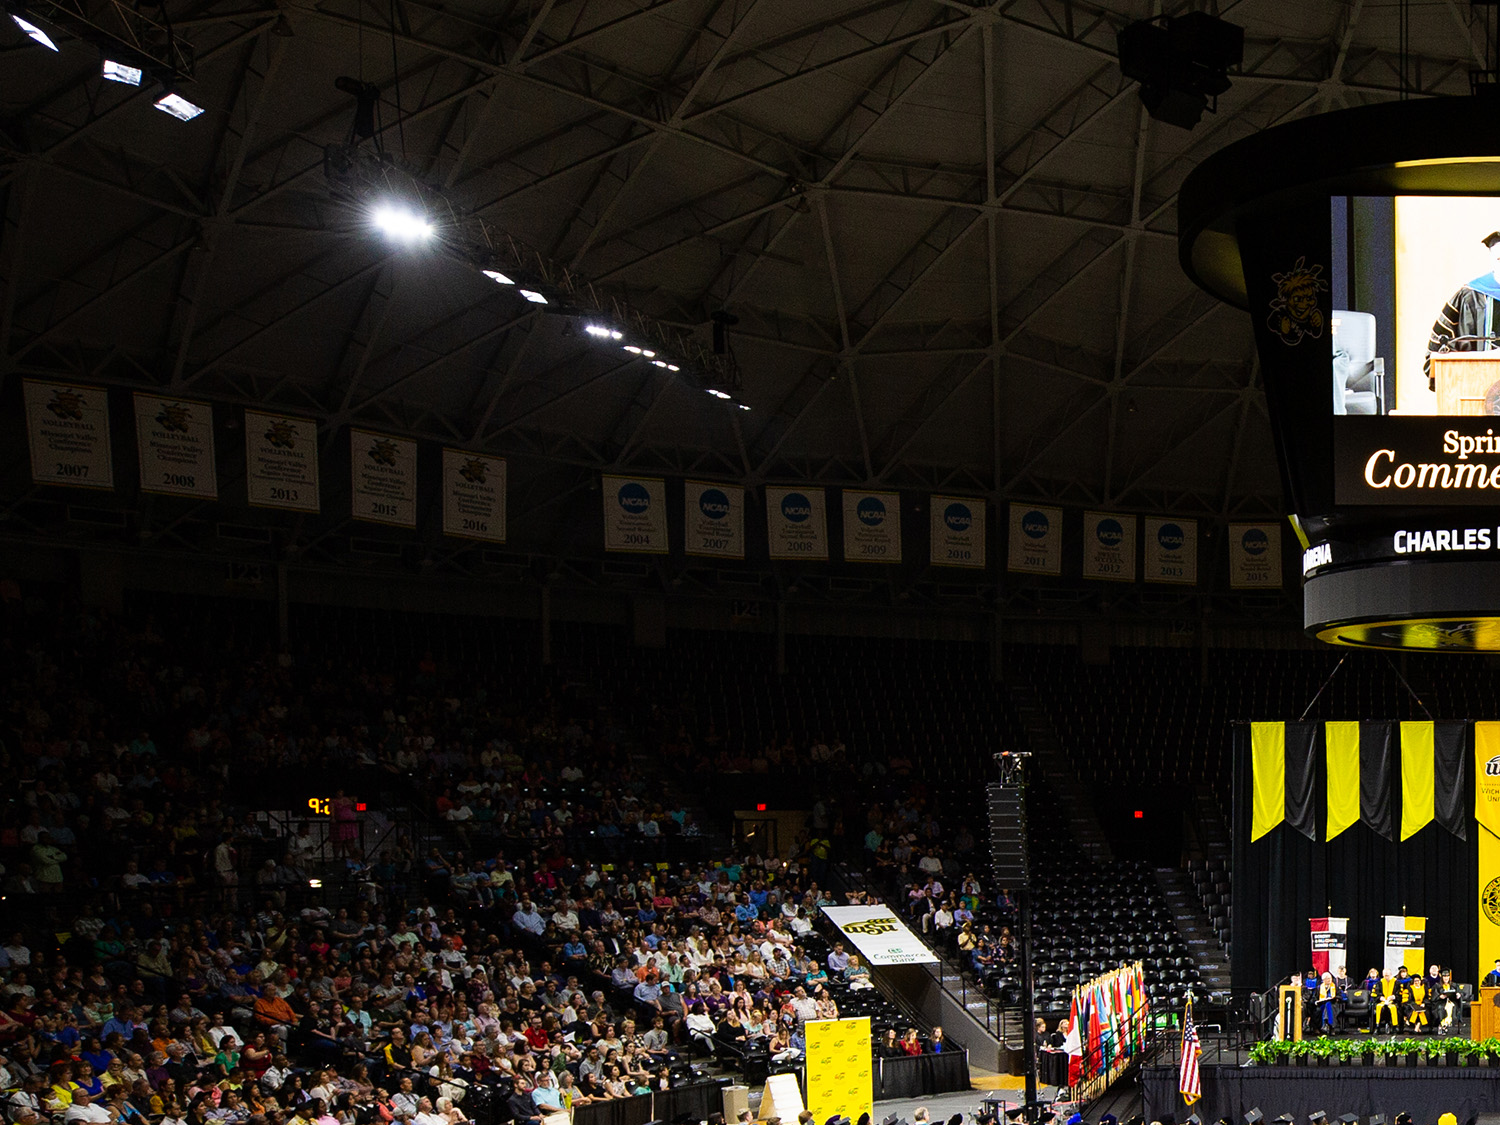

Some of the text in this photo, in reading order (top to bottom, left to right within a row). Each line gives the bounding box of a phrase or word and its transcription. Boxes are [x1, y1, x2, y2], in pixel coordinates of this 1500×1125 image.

[42, 419, 96, 431] VOLLEYBALL
[74, 432, 98, 443] Valley
[151, 430, 200, 443] VOLLEYBALL
[259, 447, 305, 459] VOLLEYBALL
[56, 462, 89, 477] 2007
[364, 464, 405, 476] VOLLEYBALL
[163, 472, 196, 488] 2008
[454, 481, 495, 493] VOLLEYBALL
[269, 487, 299, 501] 2013
[621, 497, 650, 507] NCAA
[702, 502, 730, 513] NCAA
[371, 502, 398, 517] 2015
[784, 506, 811, 516] NCAA
[860, 510, 887, 519] NCAA
[462, 518, 488, 533] 2016
[947, 516, 972, 525] NCAA
[1025, 522, 1048, 532] NCAA
[623, 533, 650, 545] 2004
[1099, 530, 1122, 540] NCAA
[1160, 535, 1184, 544] NCAA
[702, 537, 729, 550] 2007
[787, 541, 813, 552] 2008
[1245, 540, 1269, 549] NCAA
[1393, 529, 1491, 555] CHARLES
[861, 544, 887, 555] 2009
[947, 549, 971, 560] 2010
[1024, 555, 1046, 567] 2011
[1098, 562, 1121, 574] 2012
[1160, 566, 1183, 577] 2013
[1245, 571, 1268, 581] 2015
